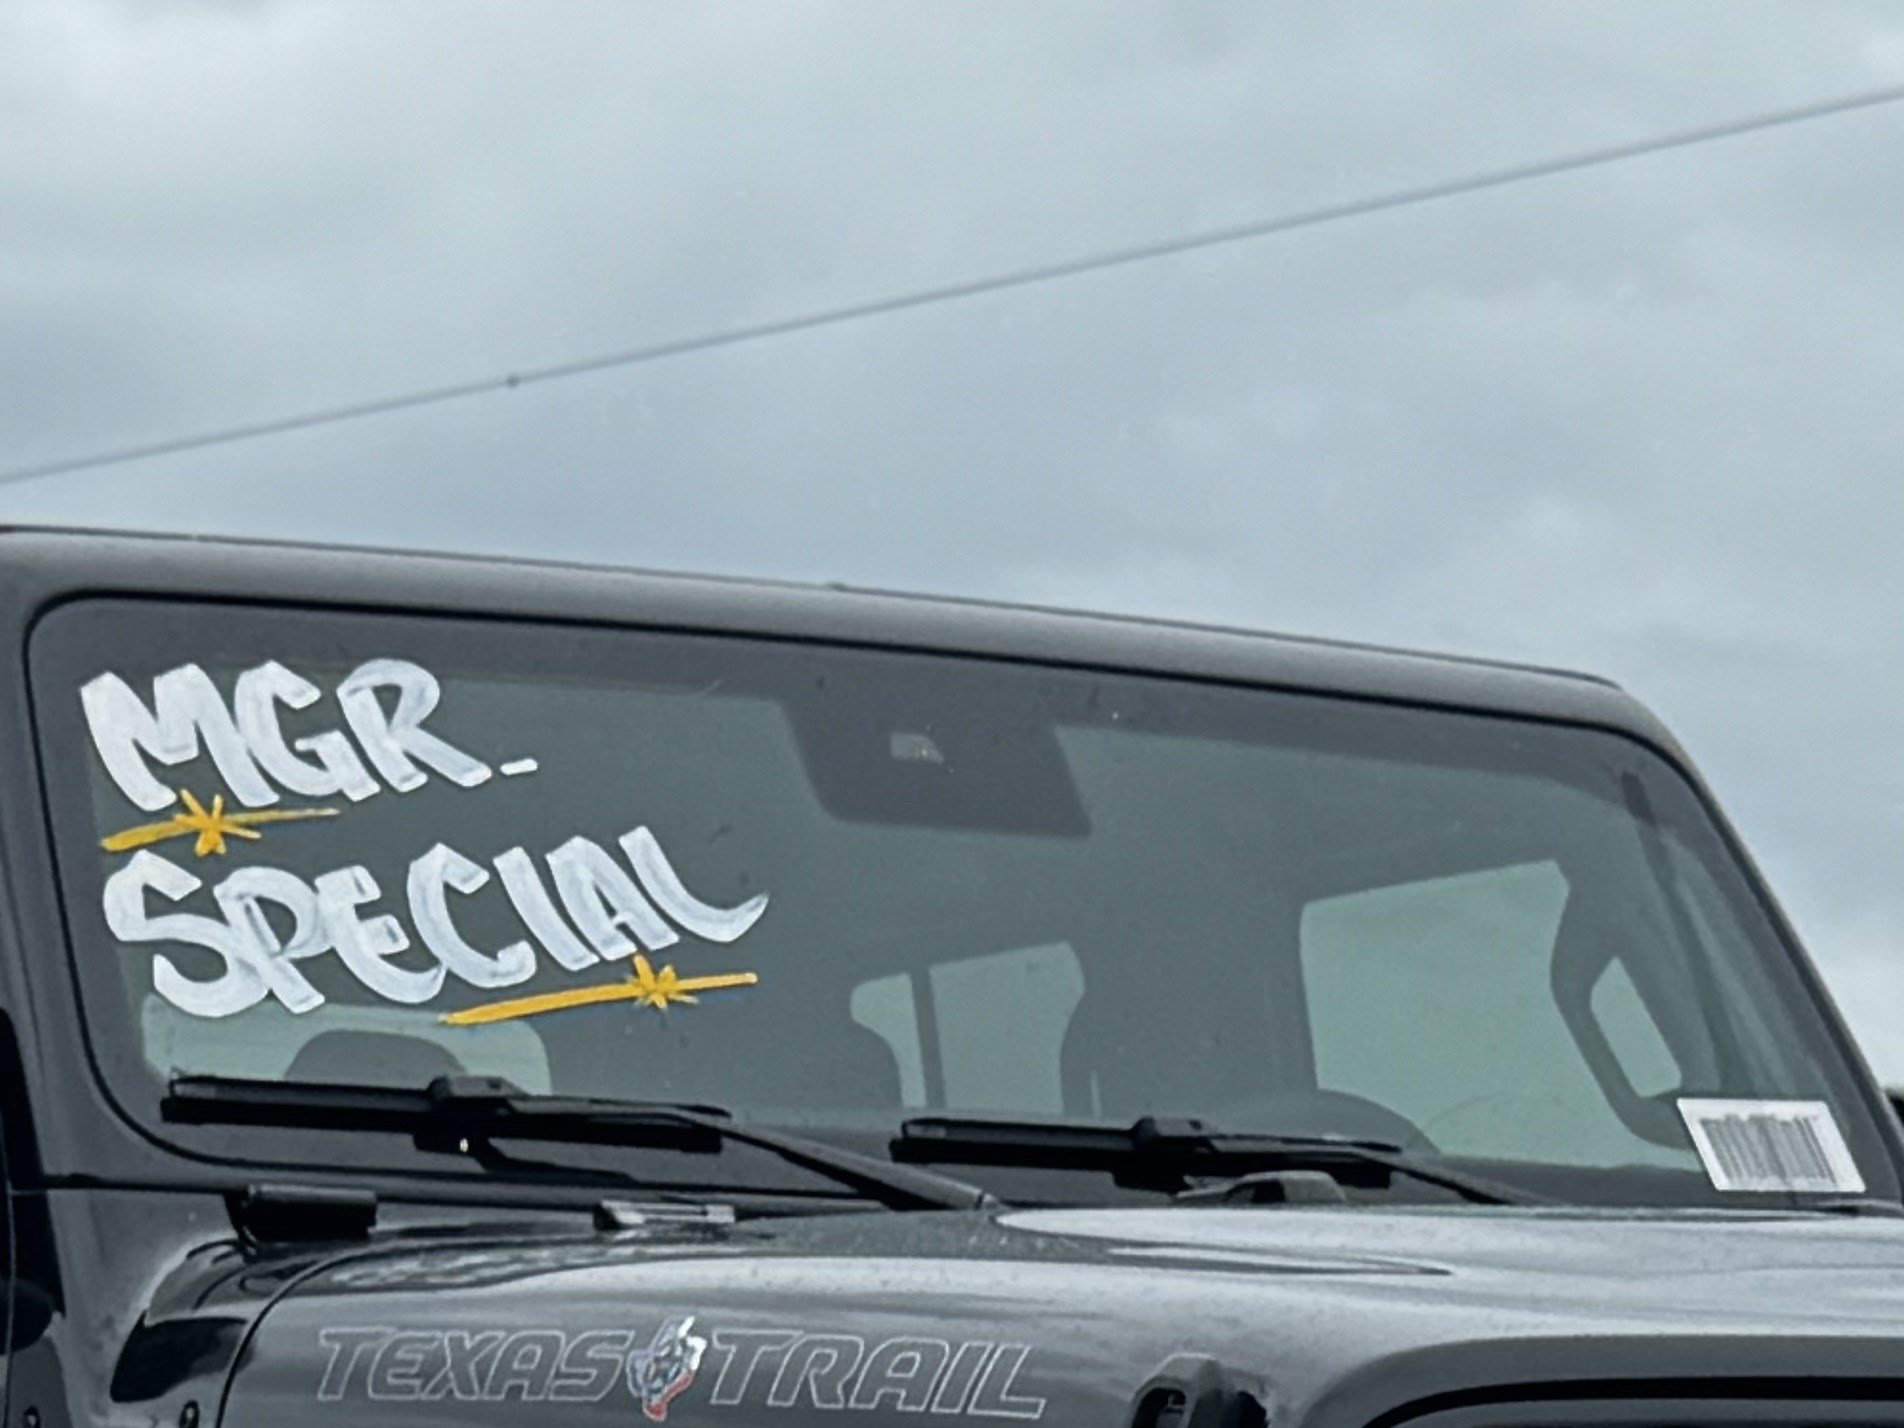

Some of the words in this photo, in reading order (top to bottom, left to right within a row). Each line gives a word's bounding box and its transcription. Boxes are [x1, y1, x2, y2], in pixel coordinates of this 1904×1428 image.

[102, 826, 770, 1018] SPECIAL
[317, 1328, 636, 1402] TEXAS
[710, 1329, 1047, 1420] TRAIL
